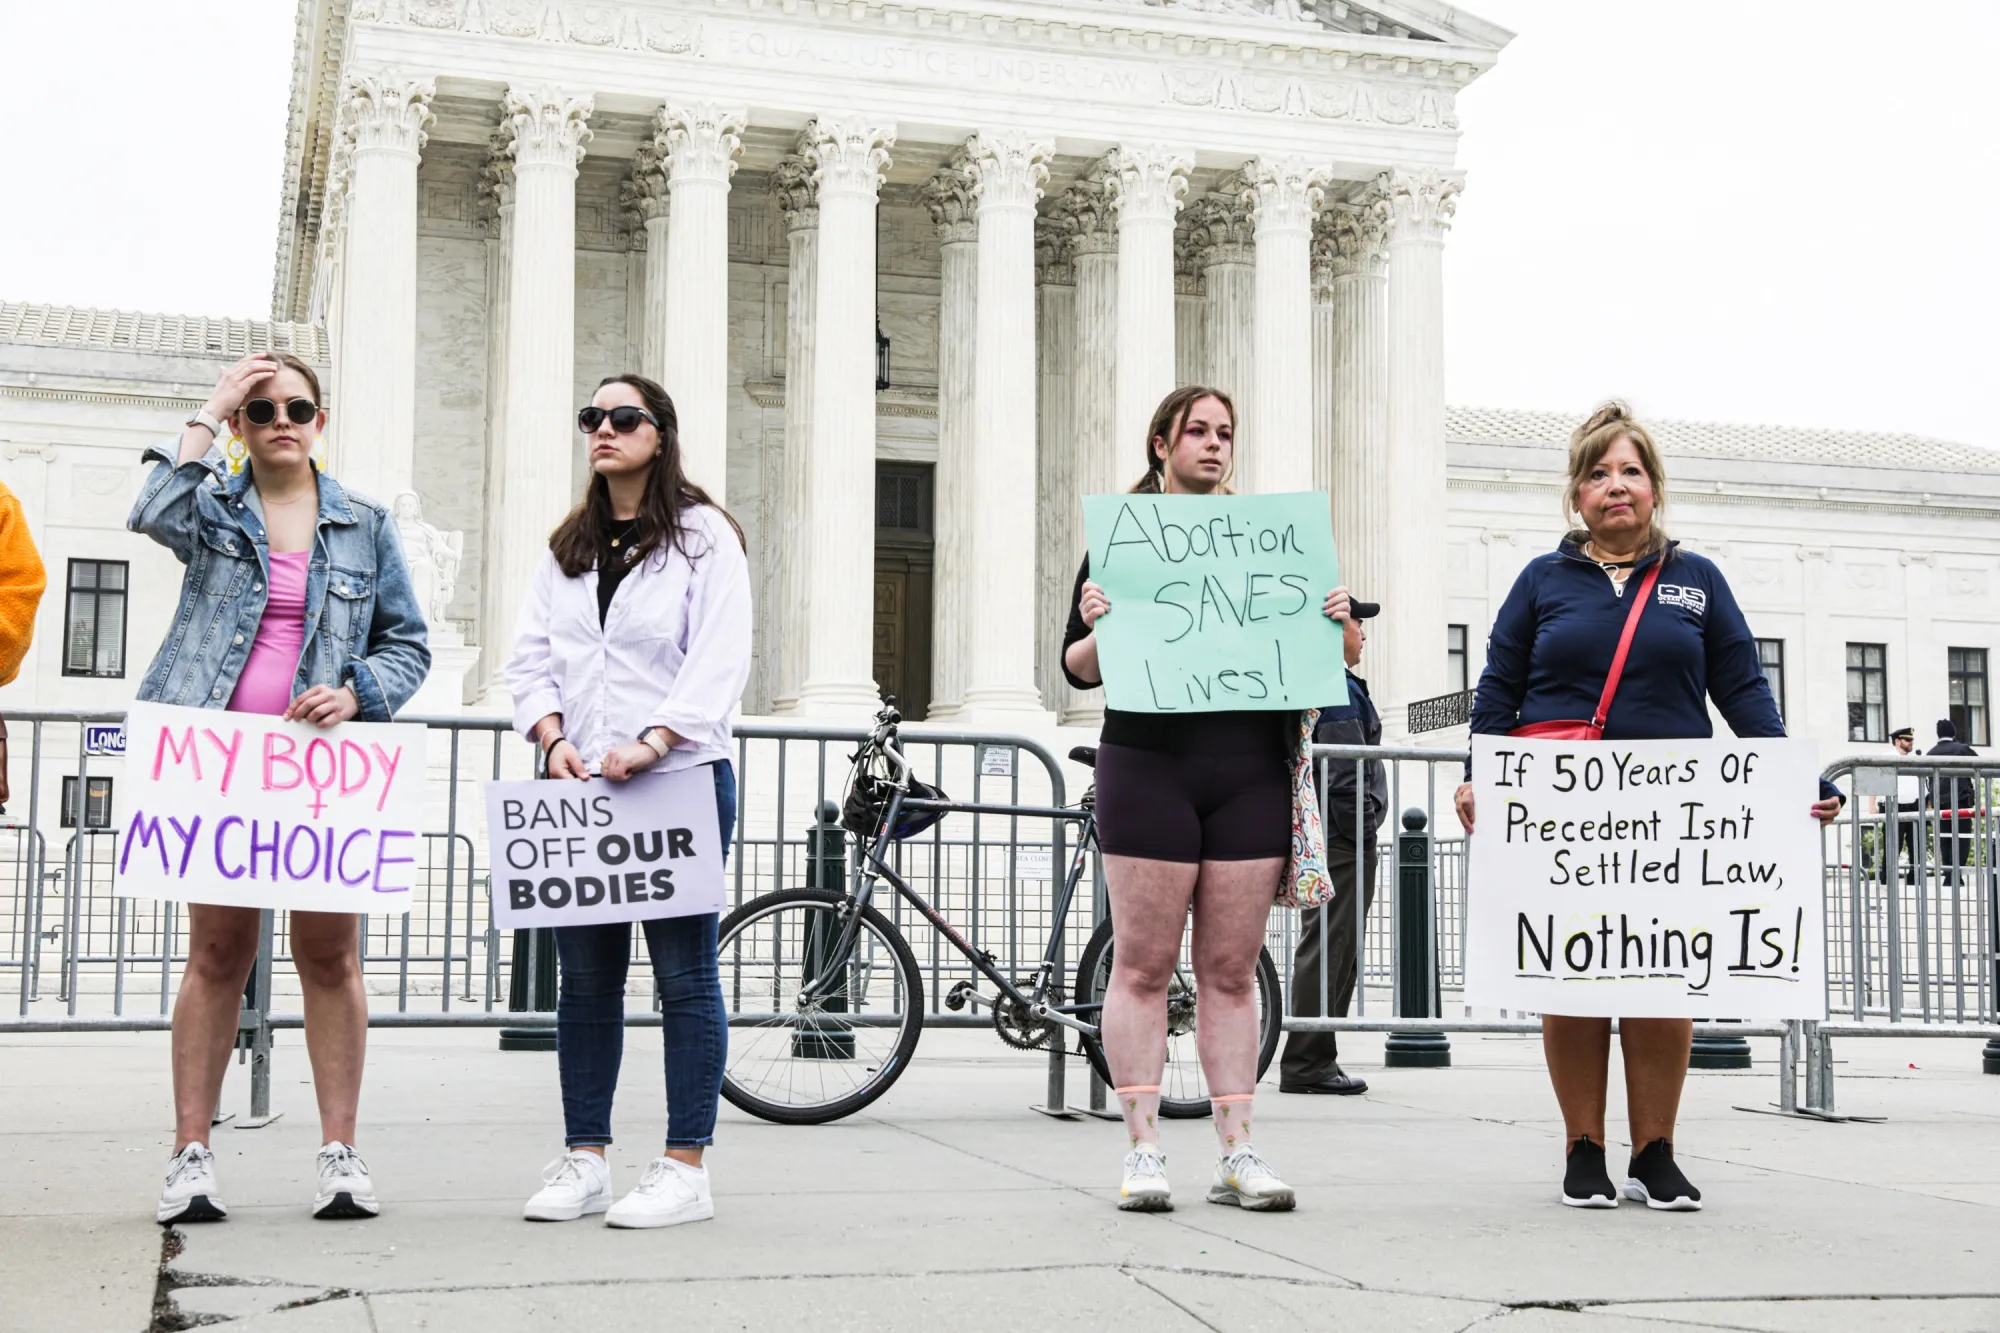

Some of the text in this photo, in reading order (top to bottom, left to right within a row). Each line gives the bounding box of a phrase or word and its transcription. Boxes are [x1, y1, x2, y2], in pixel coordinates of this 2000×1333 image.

[728, 30, 1138, 91] EQUAL JUSTICE UNDER LAW
[1102, 502, 1304, 569] Abortion
[1154, 571, 1308, 643] SAVES
[1145, 639, 1288, 710] Lives!
[90, 728, 126, 748] LONG
[151, 725, 402, 819] MY BODY
[1495, 752, 1534, 787] If
[1552, 755, 1604, 792] 50
[1612, 752, 1698, 790] Years
[504, 796, 613, 830] BANS
[1506, 802, 1754, 842] Precedent Isn't
[120, 810, 415, 893] MY CHOICE
[506, 828, 696, 870] OFF OUR
[1550, 848, 1783, 890] Settled Law,
[509, 868, 675, 910] BODIES
[1518, 907, 1802, 990] Nothing Is!
